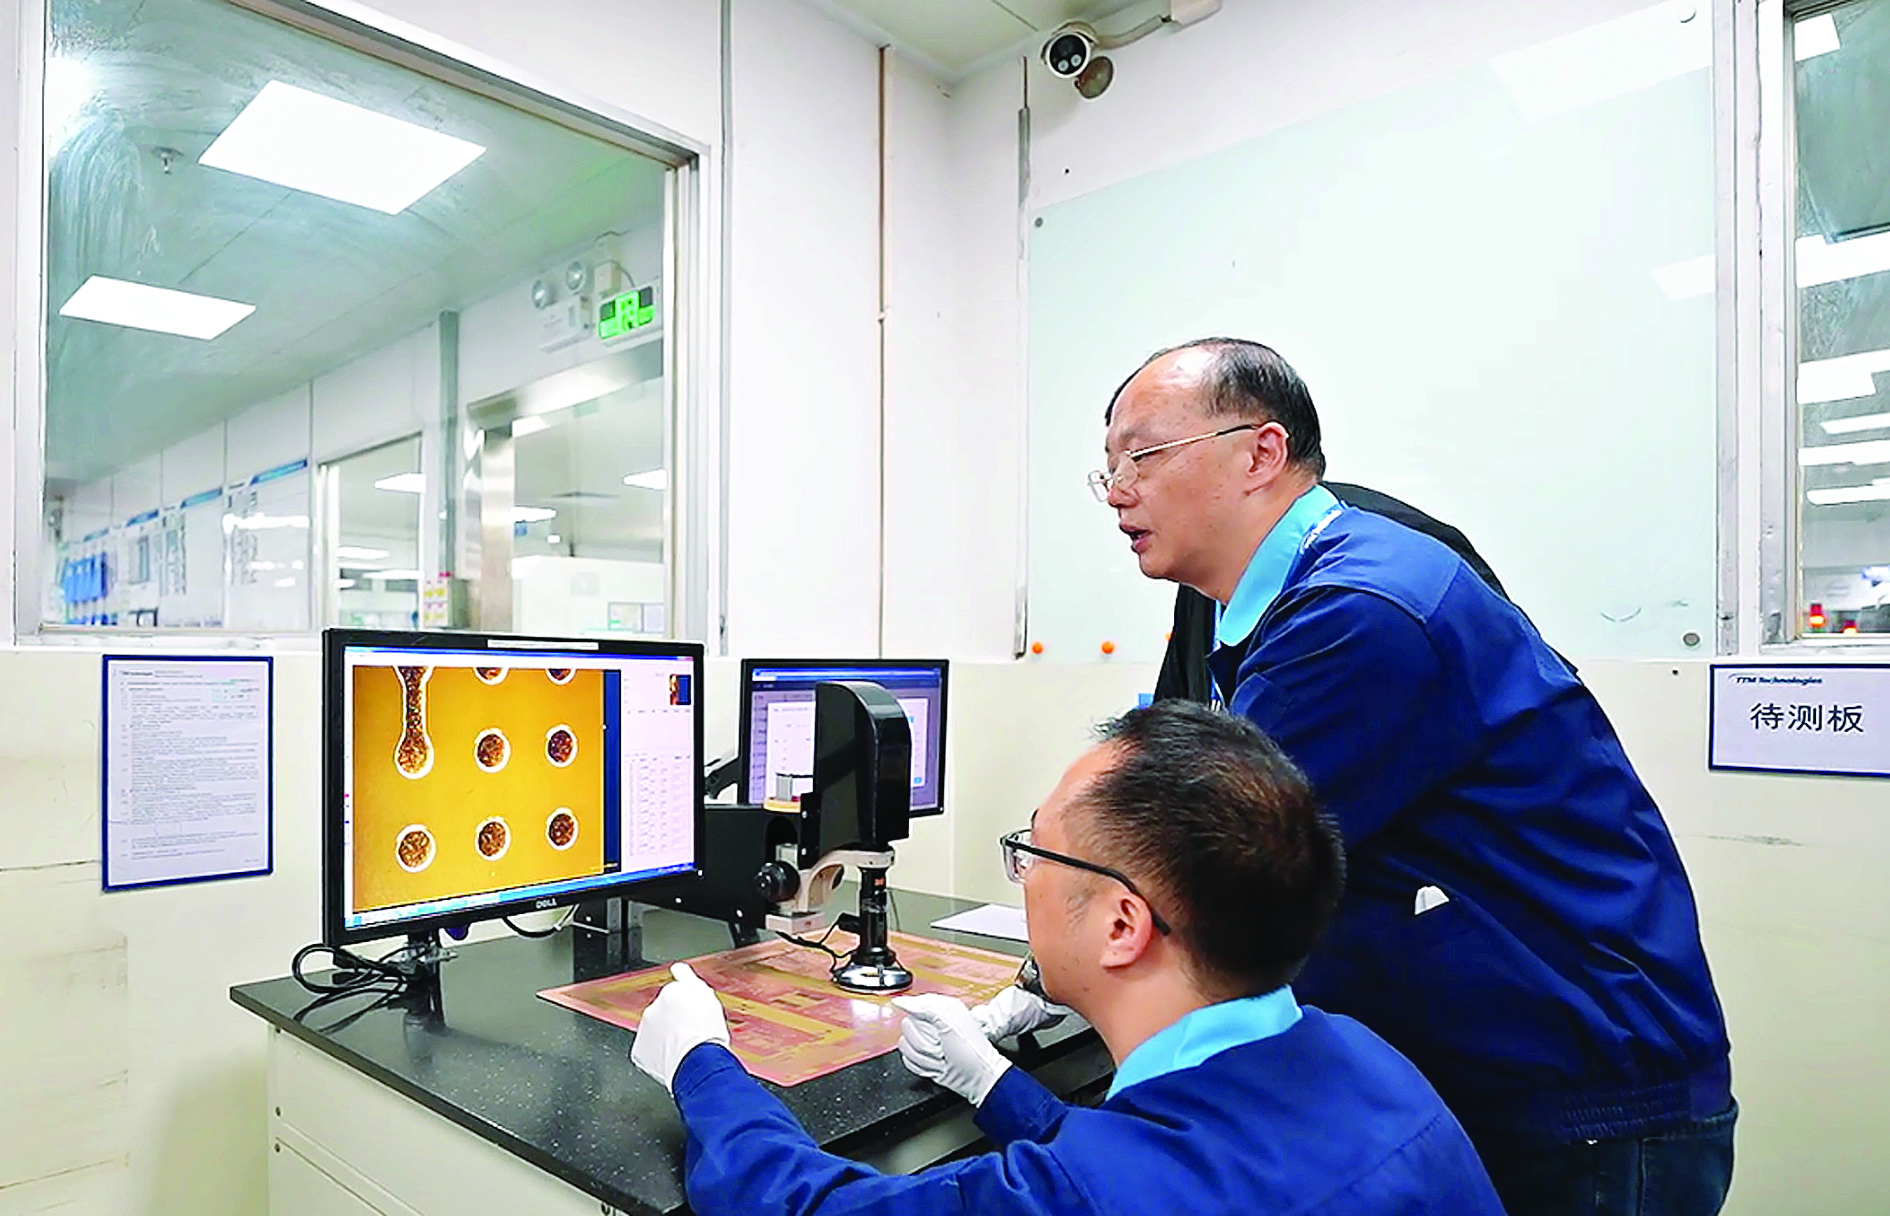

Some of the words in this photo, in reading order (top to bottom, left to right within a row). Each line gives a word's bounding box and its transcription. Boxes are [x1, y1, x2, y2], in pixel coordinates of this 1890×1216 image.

[1758, 676, 1823, 686] Technologies
[1750, 702, 1864, 732] 待测板
[535, 897, 558, 910] DELL
